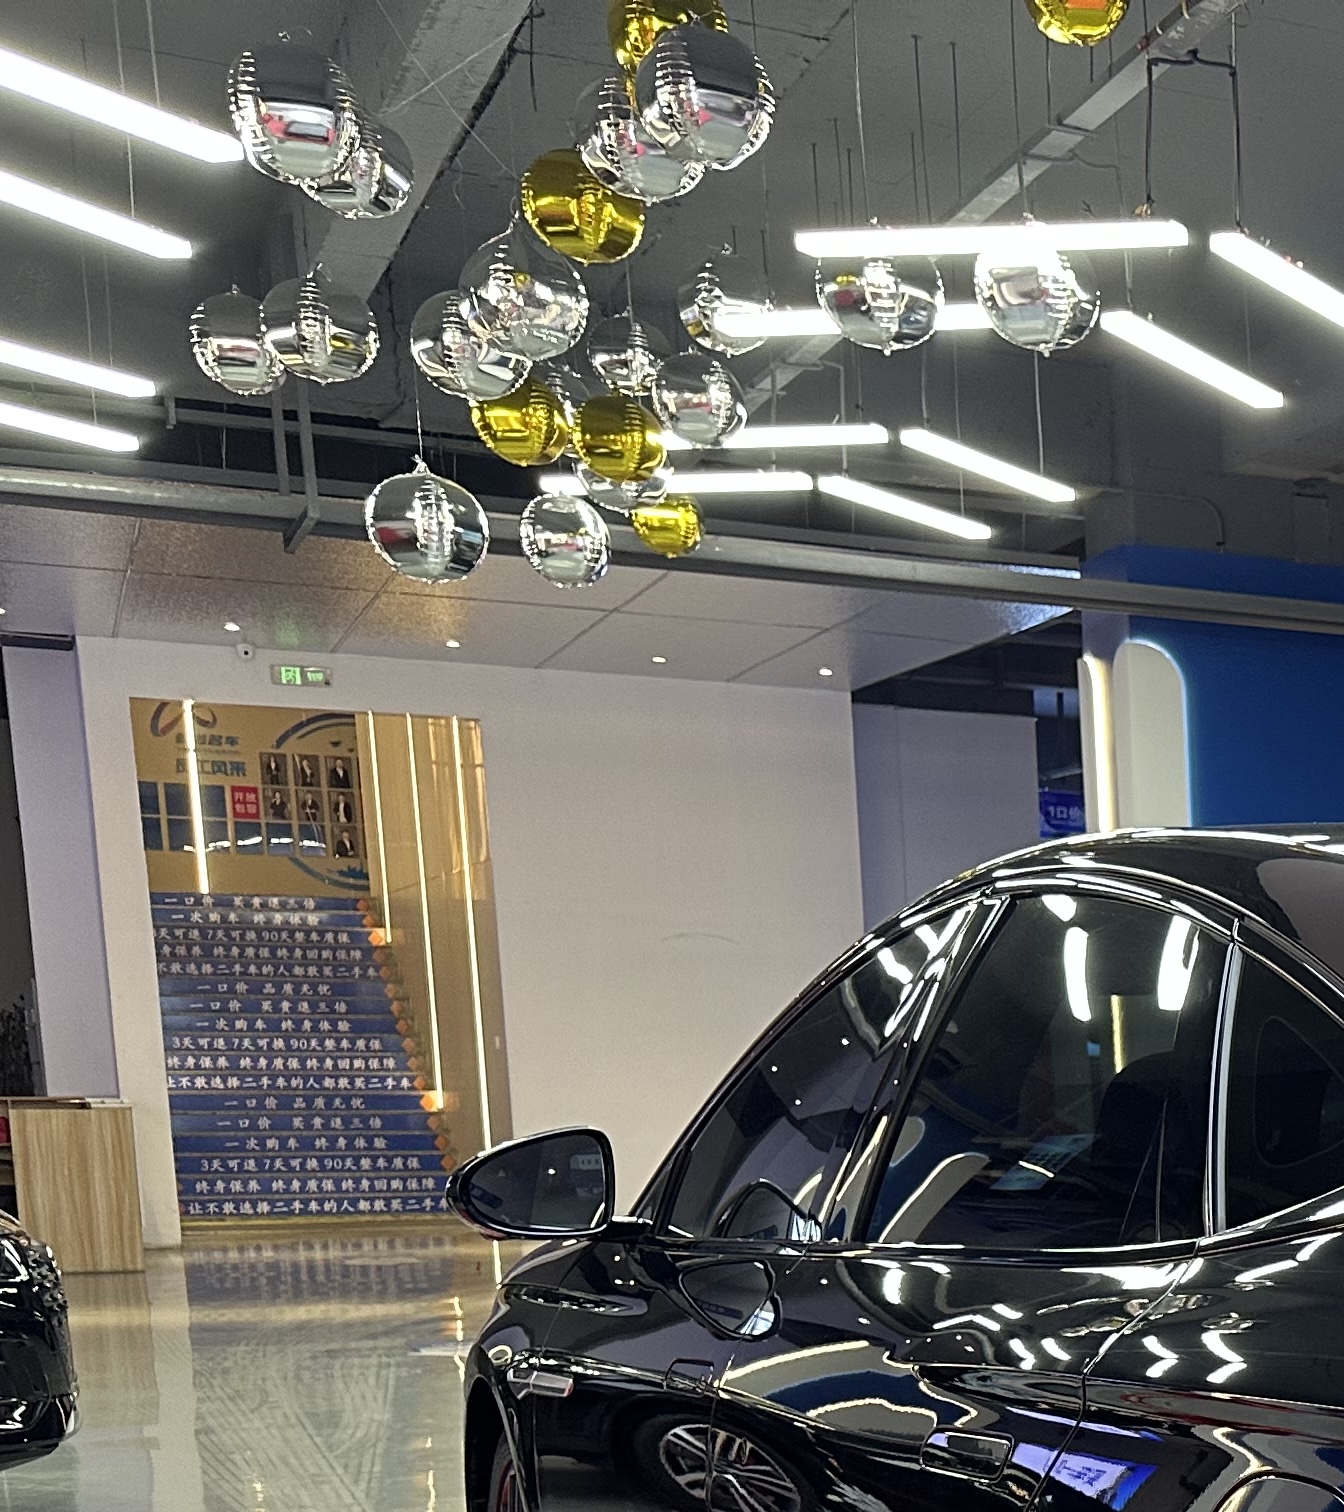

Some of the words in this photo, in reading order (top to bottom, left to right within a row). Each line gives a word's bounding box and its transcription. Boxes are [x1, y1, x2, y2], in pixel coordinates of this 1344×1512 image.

[290, 1038, 383, 1052] 90天整车质保
[223, 1096, 278, 1111] 一口价
[216, 1116, 272, 1130] 一口价
[223, 1136, 301, 1151] 一次购车
[200, 1157, 260, 1173] 3天可退
[323, 1156, 423, 1172] 90天整车质保
[194, 1179, 262, 1195] 终身保养
[270, 1178, 338, 1194] 终身质保
[340, 1177, 438, 1193] 终身回购保障
